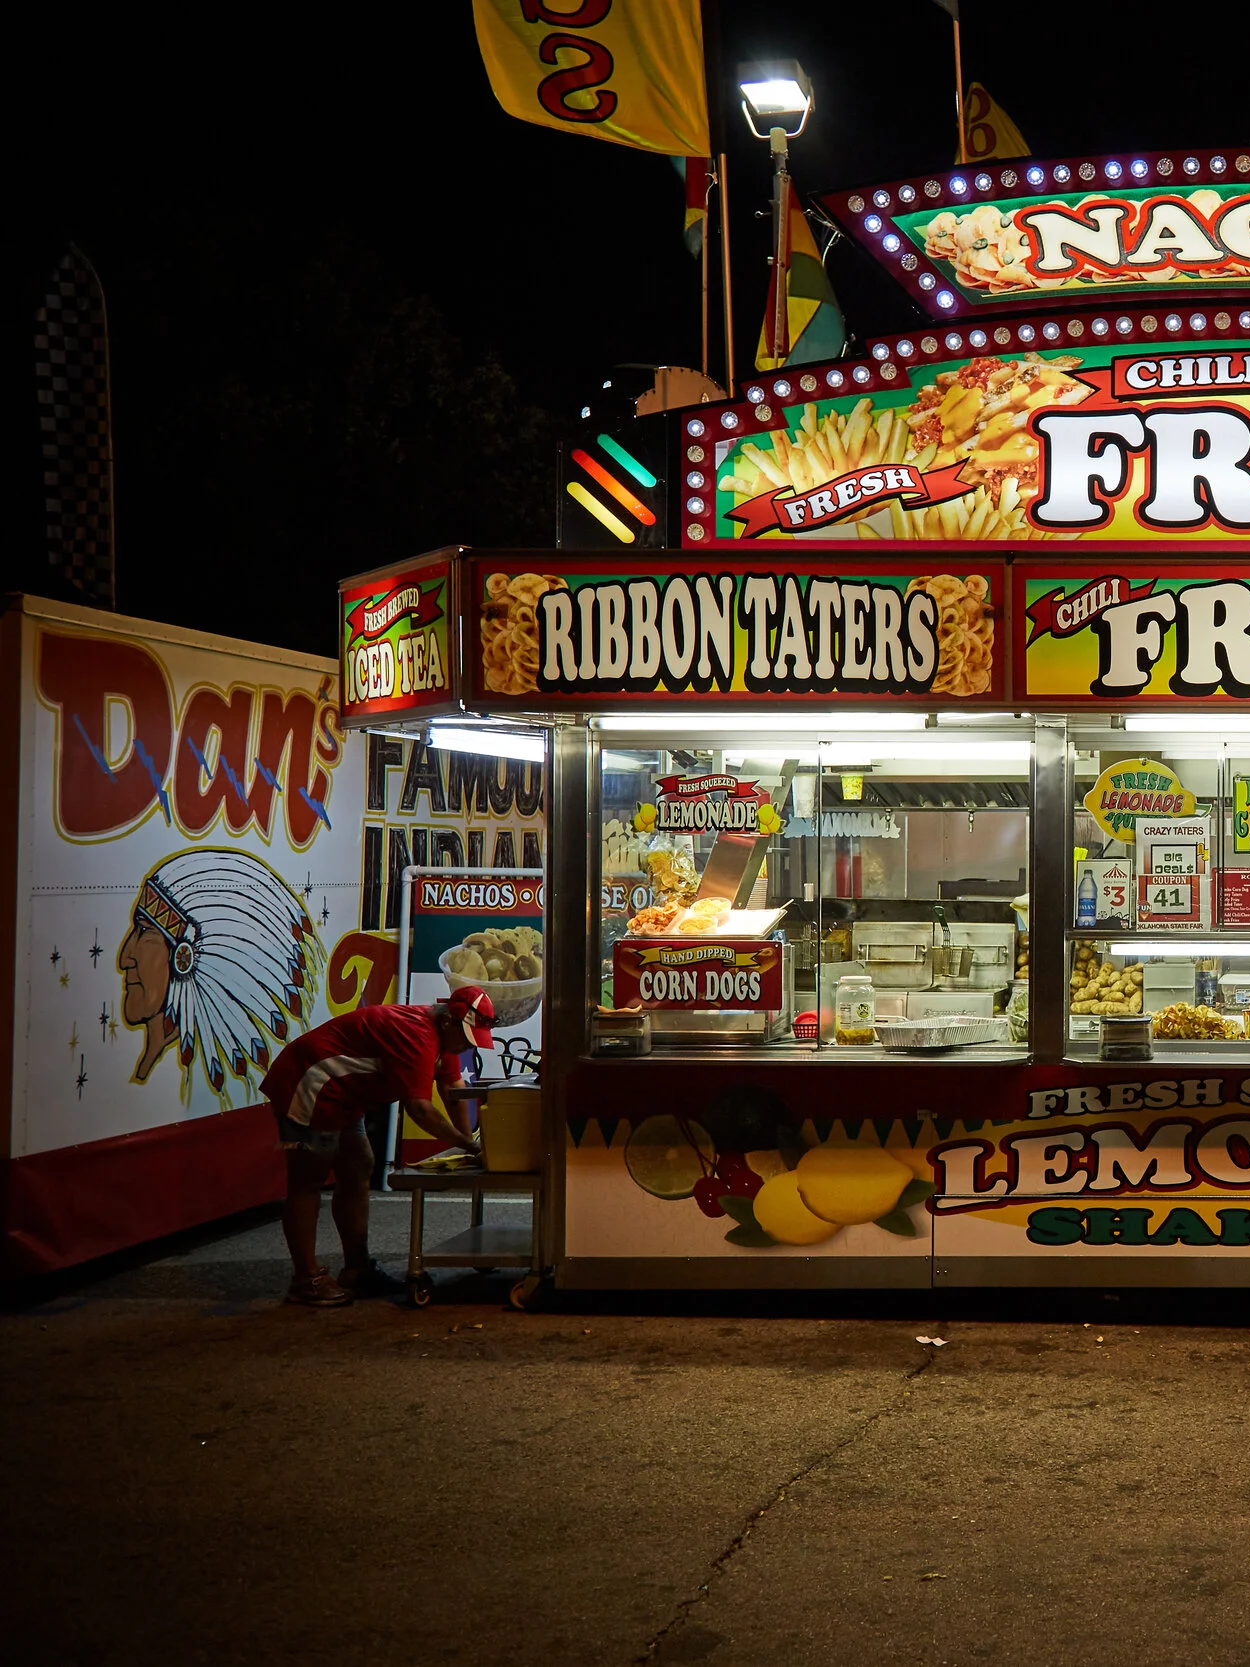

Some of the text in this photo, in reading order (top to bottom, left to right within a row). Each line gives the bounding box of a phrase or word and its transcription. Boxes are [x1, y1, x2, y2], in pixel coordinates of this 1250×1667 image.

[783, 464, 912, 528] FRESH
[363, 587, 419, 632] FRESH BREWED
[1054, 576, 1121, 627] CHILI
[539, 573, 937, 687] RIBBON TATERS
[347, 631, 445, 702] ICED TEA
[37, 627, 345, 849] Dan's
[366, 734, 543, 816] FAMOU
[678, 776, 736, 793] FRESH SQUEEZED
[1110, 772, 1173, 791] FRESH
[1100, 790, 1184, 813] LEMONADE
[657, 800, 758, 832] LEMONADE
[1143, 826, 1204, 836] CRAZY TATERS
[1164, 853, 1183, 862] BIG
[1152, 876, 1187, 885] COUPON
[422, 882, 515, 908] NACHOS
[1103, 885, 1126, 907] $3
[1153, 888, 1185, 907] 41
[662, 947, 734, 964] HAND DIPPED
[639, 970, 761, 1001] CORN DOGS
[1027, 1076, 1224, 1121] FRESH
